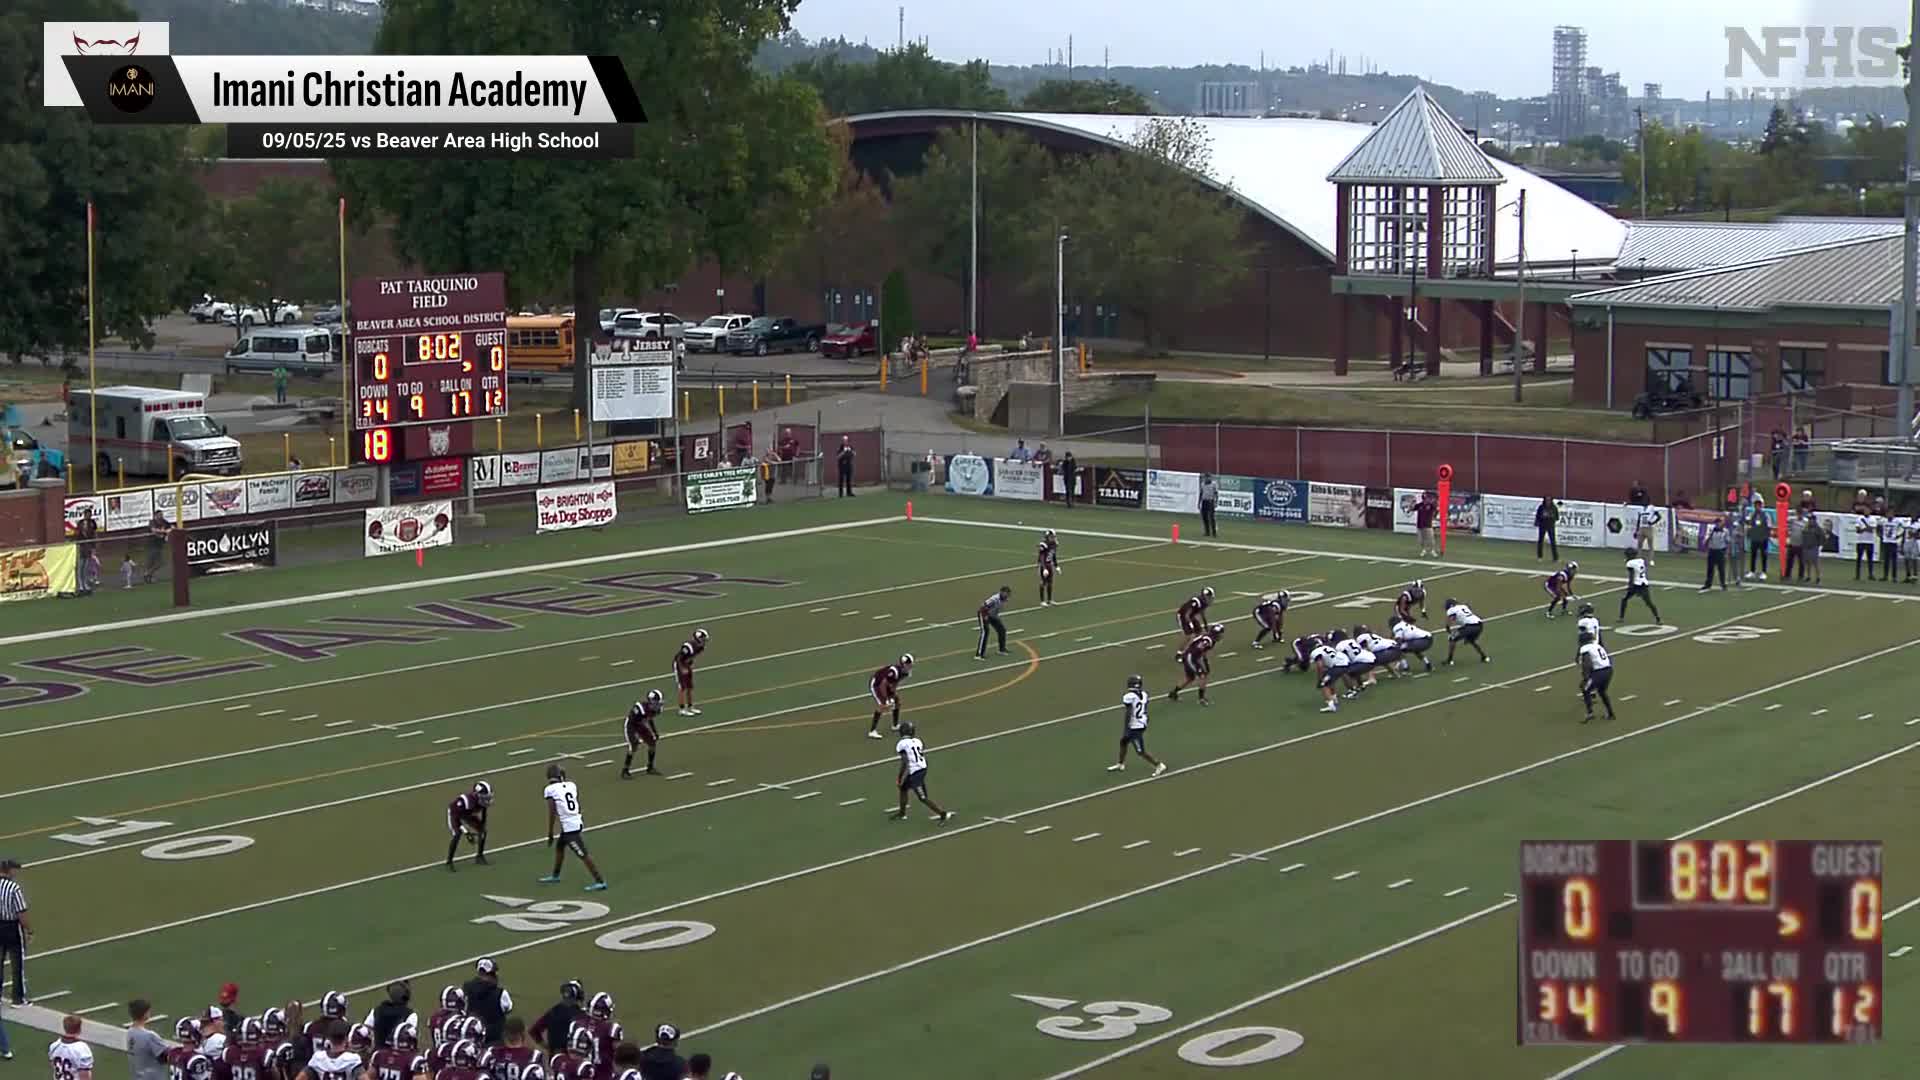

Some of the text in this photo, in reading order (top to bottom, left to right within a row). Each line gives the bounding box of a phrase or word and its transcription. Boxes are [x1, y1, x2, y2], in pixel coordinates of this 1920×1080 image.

[380, 277, 478, 294] PAT TARQUINIO
[412, 294, 448, 309] FIELD
[356, 312, 505, 331] BEAVER AREA SCHOOL DISTRICT
[357, 339, 389, 354] BOBCATS
[418, 333, 461, 360] 8:02
[475, 332, 504, 346] GUEST
[374, 353, 387, 380] 0
[490, 345, 503, 371] 0
[360, 384, 389, 399] DOWN
[397, 381, 423, 396] TO GO
[460, 378, 472, 390] ON
[481, 376, 499, 390] QTR
[410, 395, 424, 418] 9
[451, 391, 470, 415] 17
[364, 428, 388, 460] 18
[556, 492, 595, 508] BRIGHTON
[1098, 487, 1140, 500] TRASIM
[540, 506, 613, 526] Hot Dog Shoppe
[1557, 511, 1593, 529] ATTEN
[244, 547, 270, 559] OIL CO
[1135, 701, 1143, 719] 2
[565, 791, 575, 812] 6
